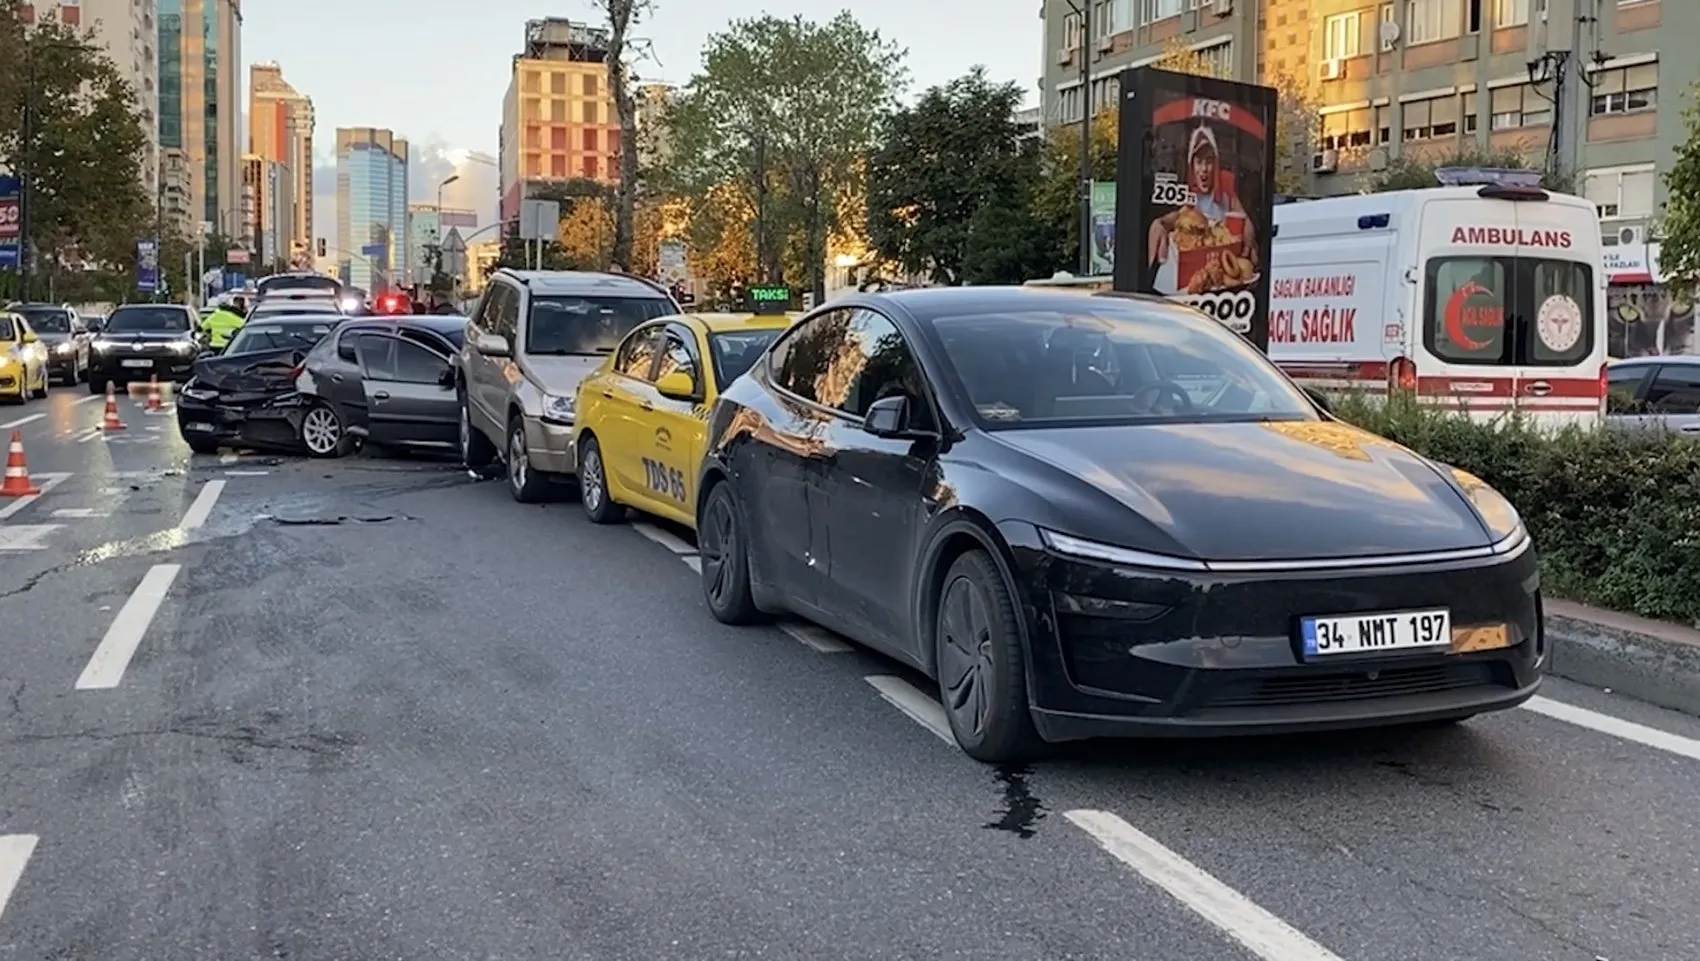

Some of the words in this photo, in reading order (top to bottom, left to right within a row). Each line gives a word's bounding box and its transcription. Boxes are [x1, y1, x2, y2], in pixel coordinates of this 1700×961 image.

[1192, 99, 1231, 120] KFC
[1452, 227, 1571, 248] AMBULANS
[1301, 304, 1356, 342] SAĞLIK
[641, 456, 669, 494] TDS
[1317, 622, 1344, 649] 34
[1358, 618, 1398, 647] NMT
[1408, 614, 1445, 643] 197
